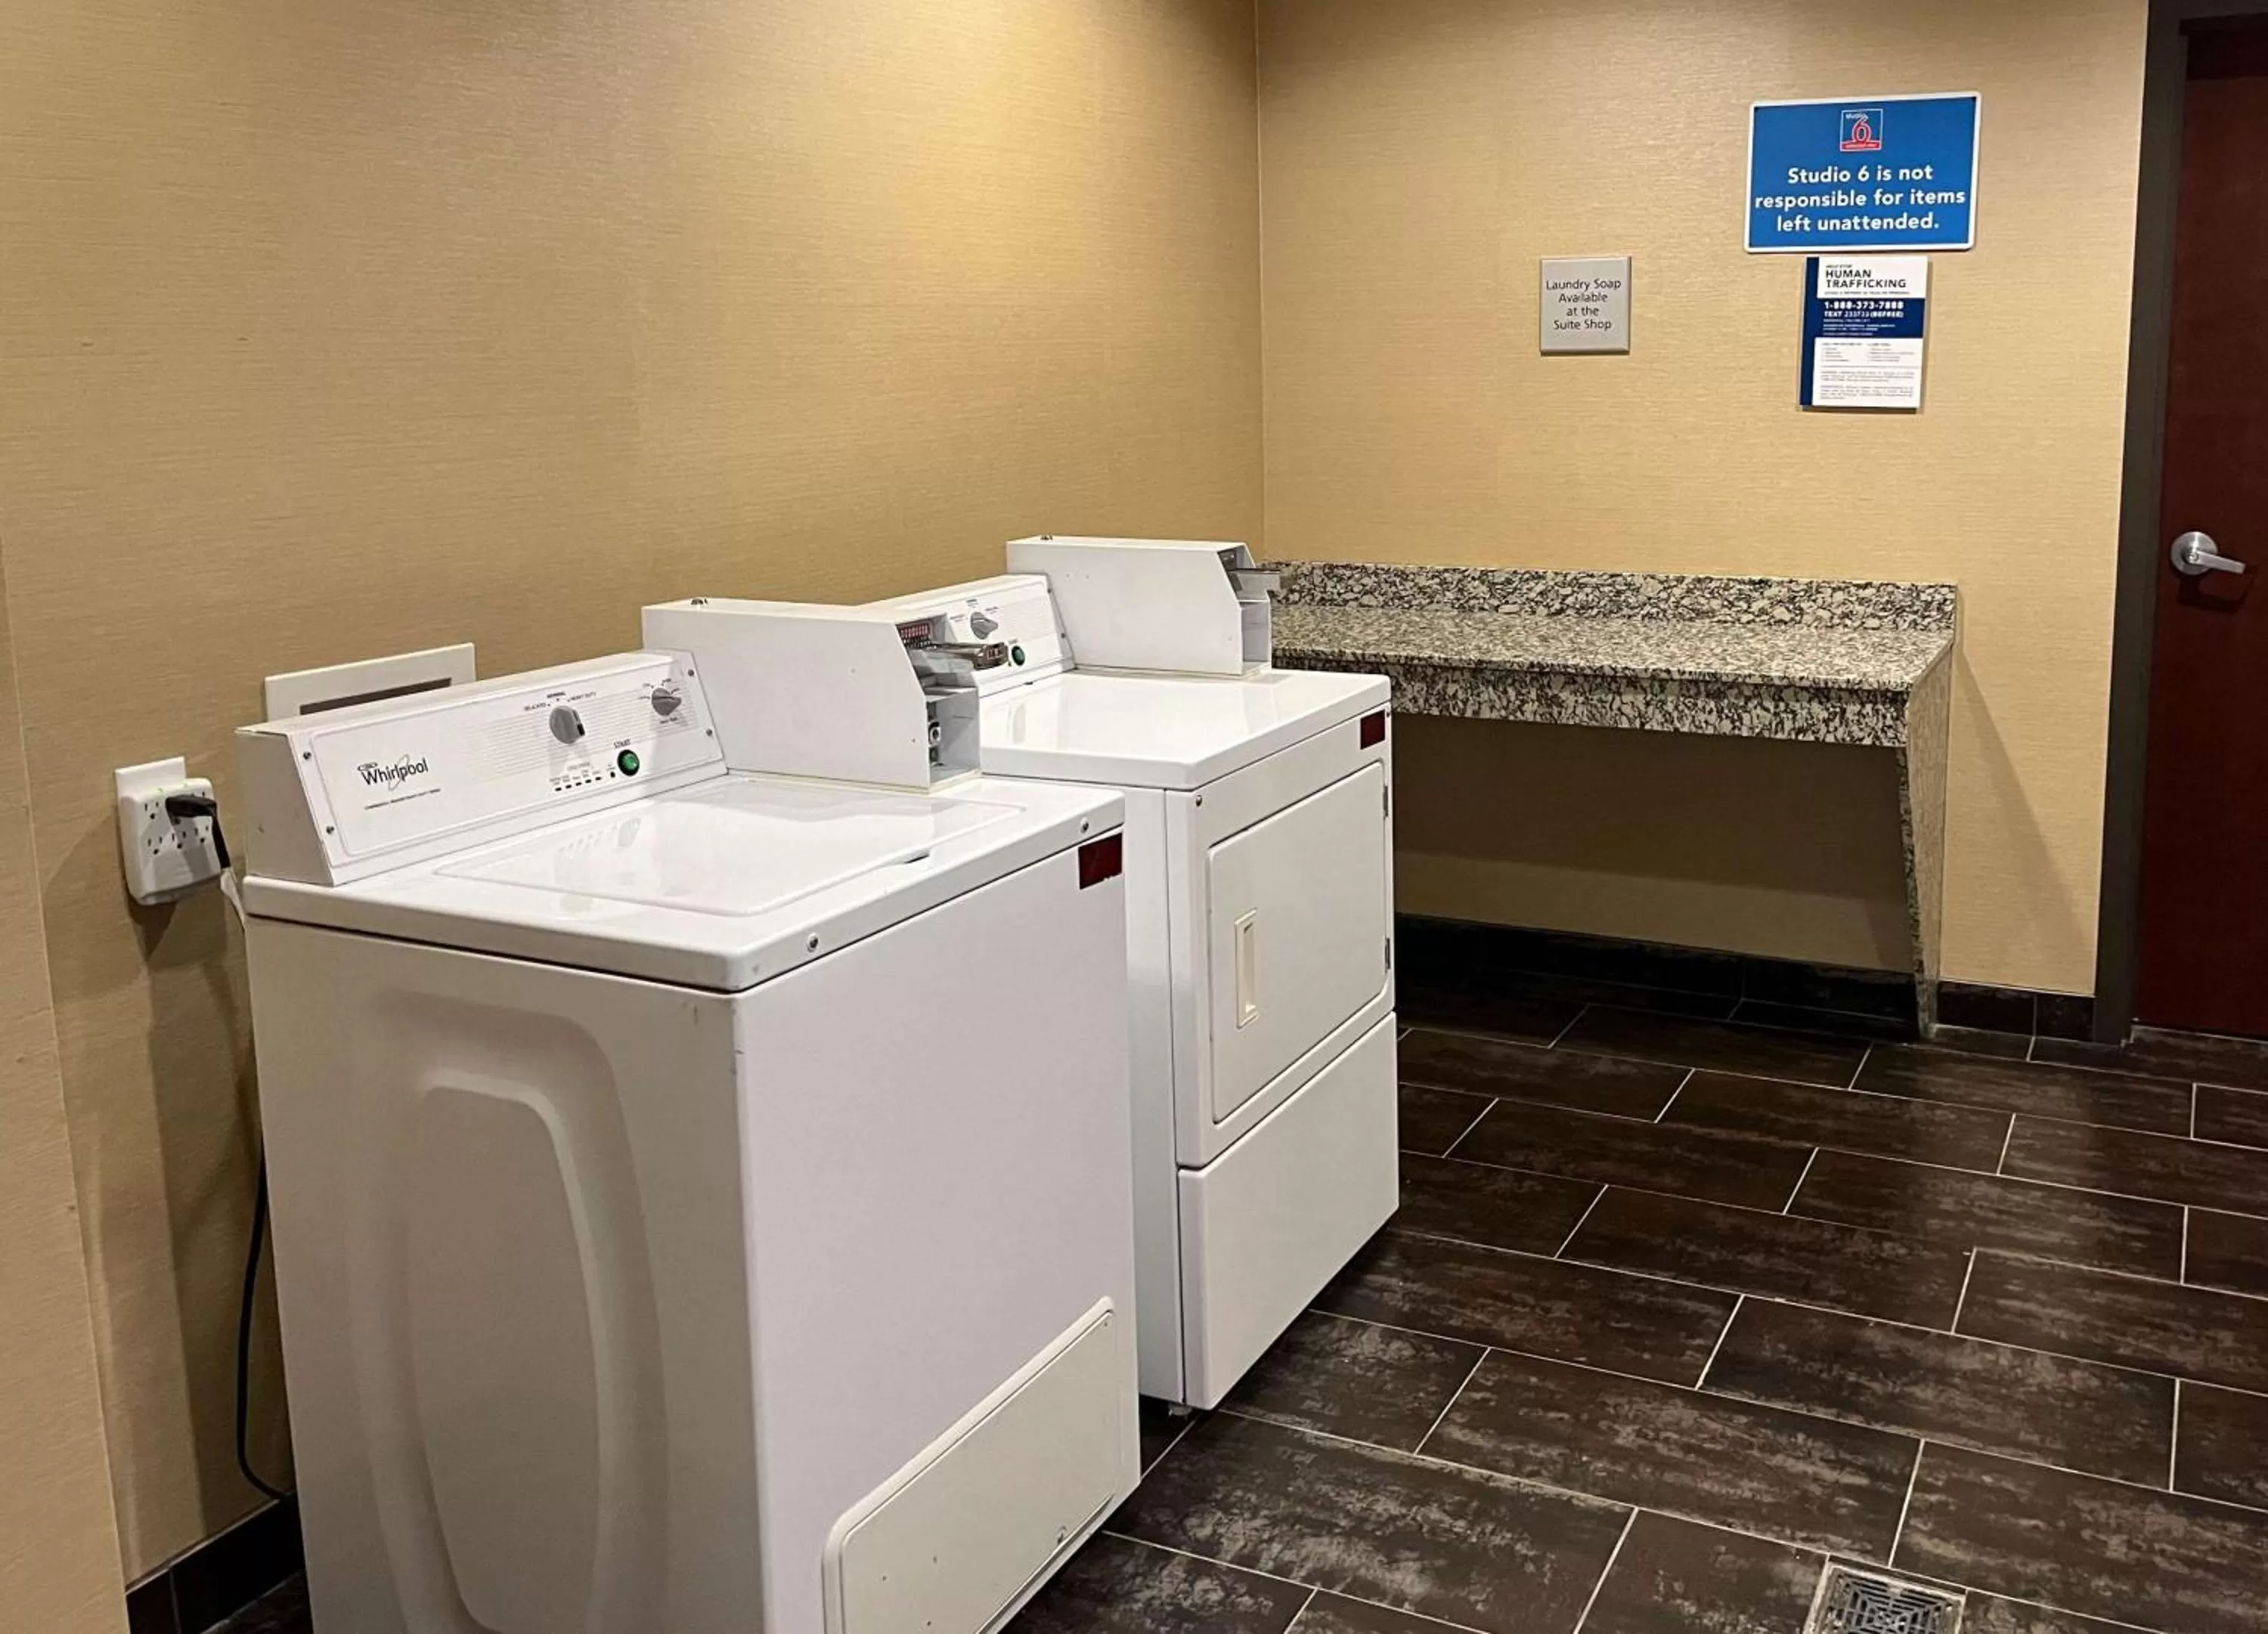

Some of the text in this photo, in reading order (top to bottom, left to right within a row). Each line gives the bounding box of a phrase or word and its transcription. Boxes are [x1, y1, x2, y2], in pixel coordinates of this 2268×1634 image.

[1788, 164, 1933, 184] Studio 6 is not
[1755, 188, 1966, 210] responsible for items
[1777, 212, 1939, 232] left unattended.
[1826, 268, 1872, 278] HUMAN
[1546, 278, 1622, 292] Laundry Soap
[1826, 279, 1907, 288] TRAFFICKING
[1558, 292, 1608, 303] Available
[1566, 305, 1600, 317] at the
[1554, 319, 1612, 331] Suite Shop
[361, 757, 429, 786] Whirlpool
